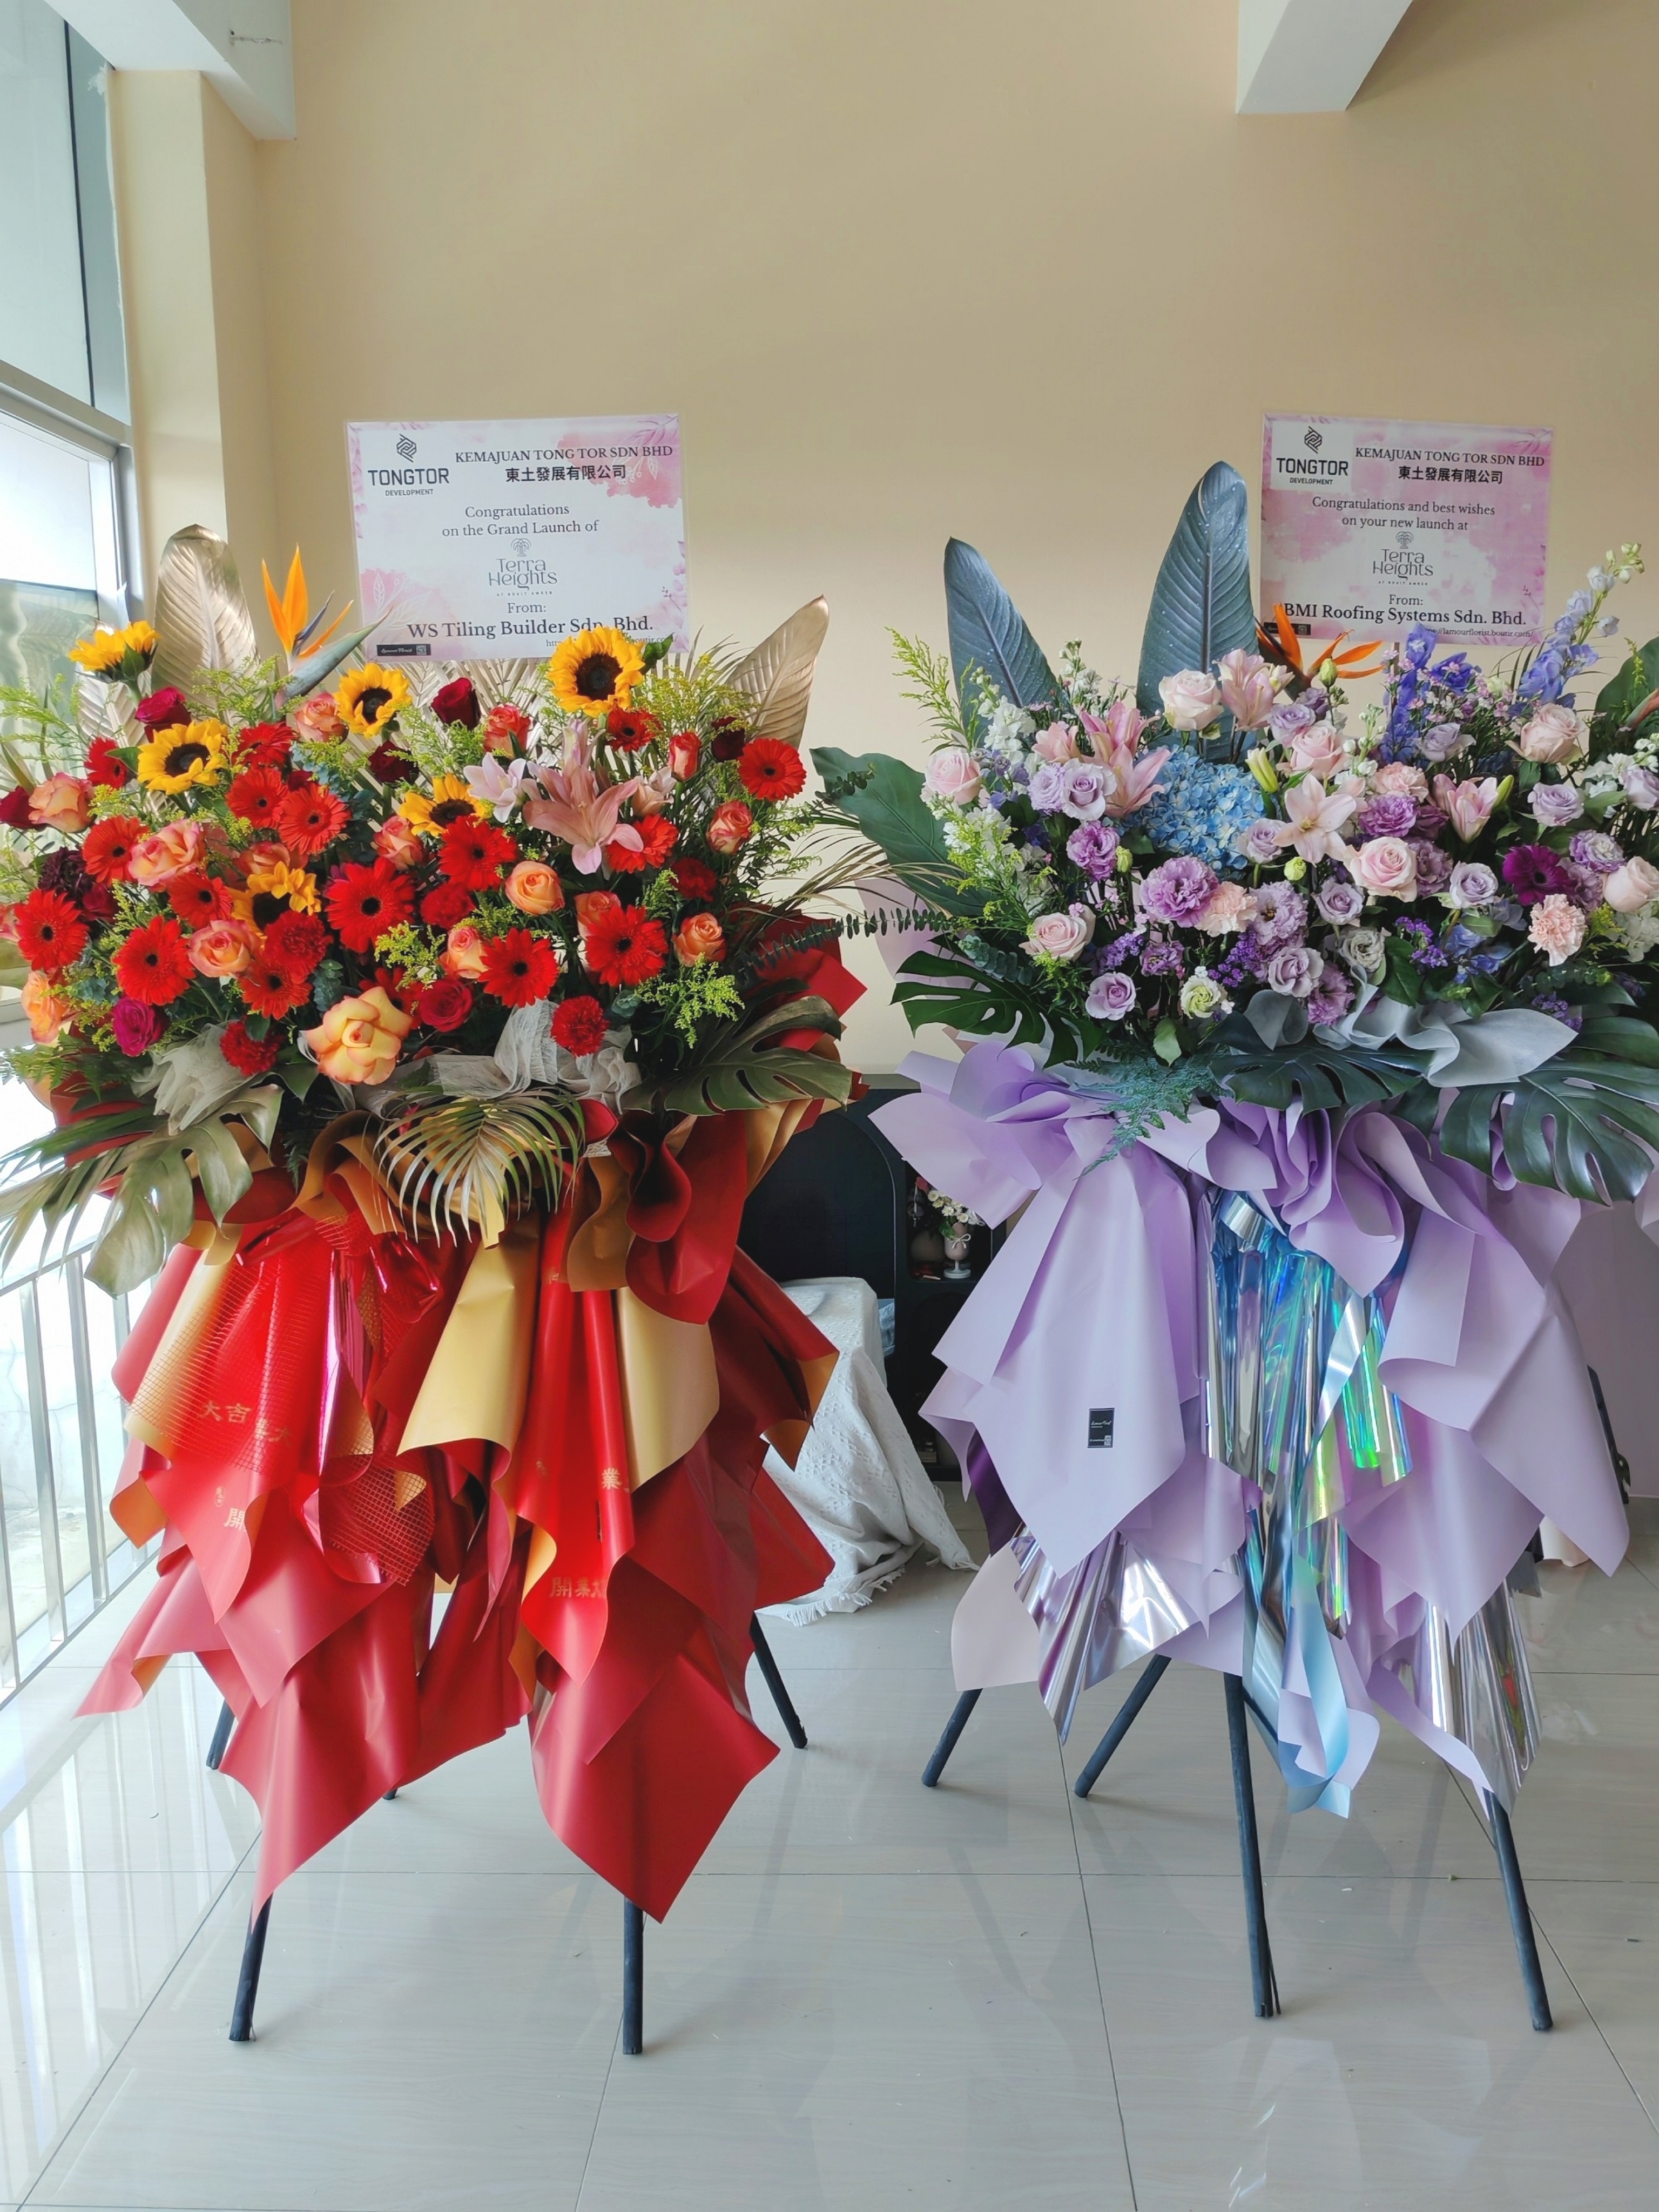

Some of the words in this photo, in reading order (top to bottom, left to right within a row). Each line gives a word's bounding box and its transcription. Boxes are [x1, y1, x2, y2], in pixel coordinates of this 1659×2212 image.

[455, 450, 530, 465] KEMAJUAN
[533, 449, 575, 461] TONG
[577, 448, 608, 459] TOR
[610, 446, 638, 458] SDN
[643, 446, 673, 456] BHD
[1355, 447, 1421, 461] KEMAJUAN
[1424, 451, 1461, 462] TONG
[1462, 453, 1488, 463] TOR
[1490, 455, 1515, 464] SDN
[1518, 456, 1545, 467] BHD
[505, 464, 626, 482] 東土發展有限公司
[1276, 458, 1348, 476] TONGTOR
[1398, 466, 1502, 484] 東土發展有限公司
[368, 468, 450, 486] TONGTOR
[385, 488, 434, 496] DEVELOPMENT
[465, 504, 570, 520] Congratulations
[1312, 496, 1405, 511] Congratulations
[1408, 501, 1429, 512] and
[1433, 502, 1455, 514] best
[1458, 503, 1495, 515] wishes
[442, 527, 458, 536] on
[463, 524, 483, 536] the
[487, 522, 529, 535] Grand
[532, 520, 581, 534] Launch
[585, 520, 599, 531] of
[1342, 517, 1357, 525] on
[1360, 518, 1387, 529] your
[1390, 519, 1413, 528] new
[1417, 517, 1454, 530] launch
[1458, 521, 1468, 530] at
[496, 558, 546, 572] Terra
[1381, 549, 1425, 564] Terra
[1373, 561, 1434, 581] Heights
[489, 570, 558, 591] Heights
[507, 602, 546, 613] From:
[1389, 594, 1424, 605] From:
[1284, 603, 1318, 617] BMI
[1322, 605, 1385, 624] Roofing
[1387, 607, 1449, 624] Systems
[1454, 610, 1487, 624] Sdn.
[1492, 611, 1526, 625] Bhd.
[407, 623, 438, 638] WS
[442, 621, 496, 639] Tiling
[501, 619, 565, 636] Builder
[570, 617, 603, 632] Sdn
[613, 616, 653, 631] Bhd.
